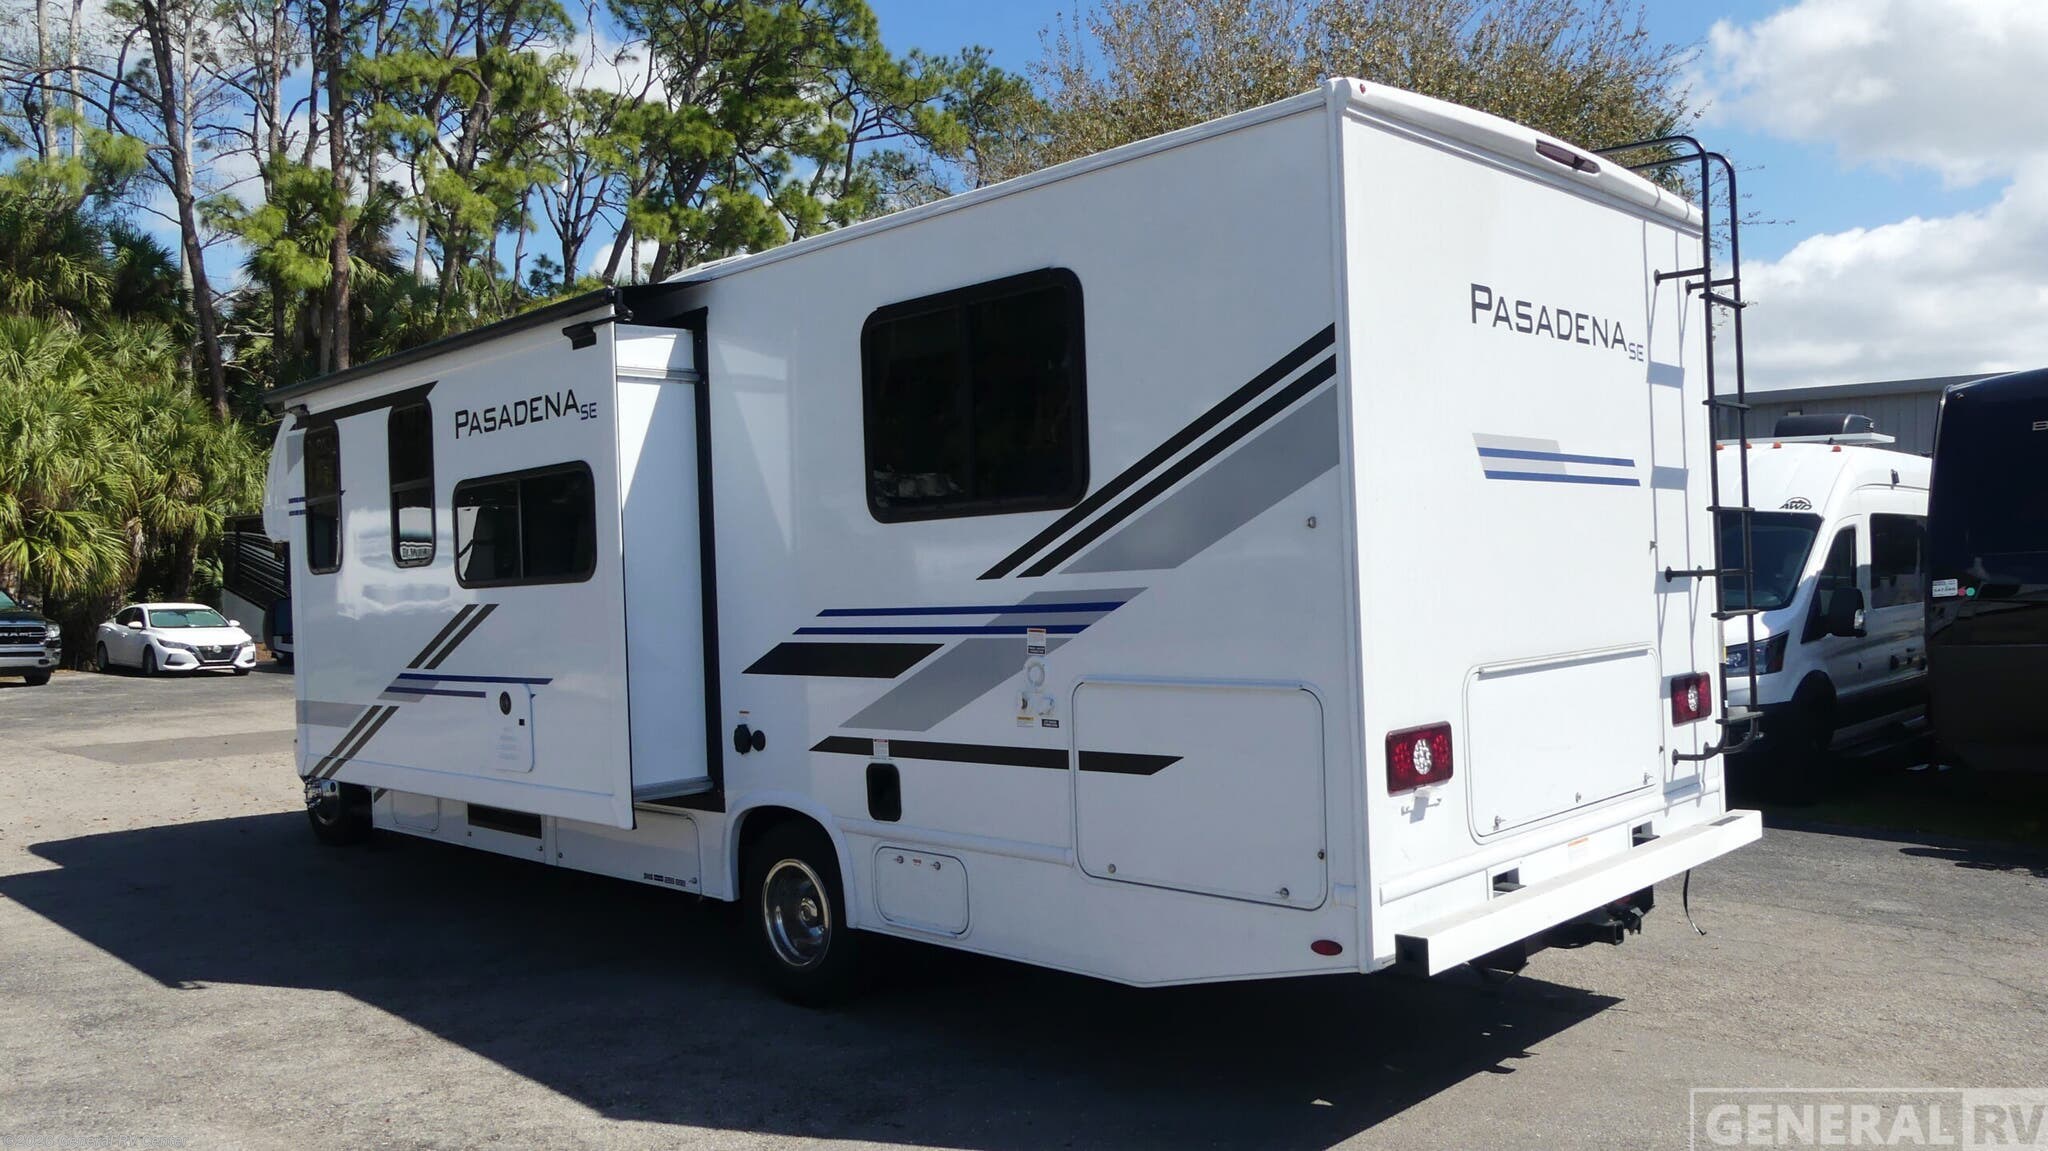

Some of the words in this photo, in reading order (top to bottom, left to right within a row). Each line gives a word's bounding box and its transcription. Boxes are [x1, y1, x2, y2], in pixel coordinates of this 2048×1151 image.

[1470, 282, 1628, 352] PASADENA
[1628, 342, 1645, 362] SE
[455, 389, 580, 439] PASADENA
[580, 402, 598, 421] SE
